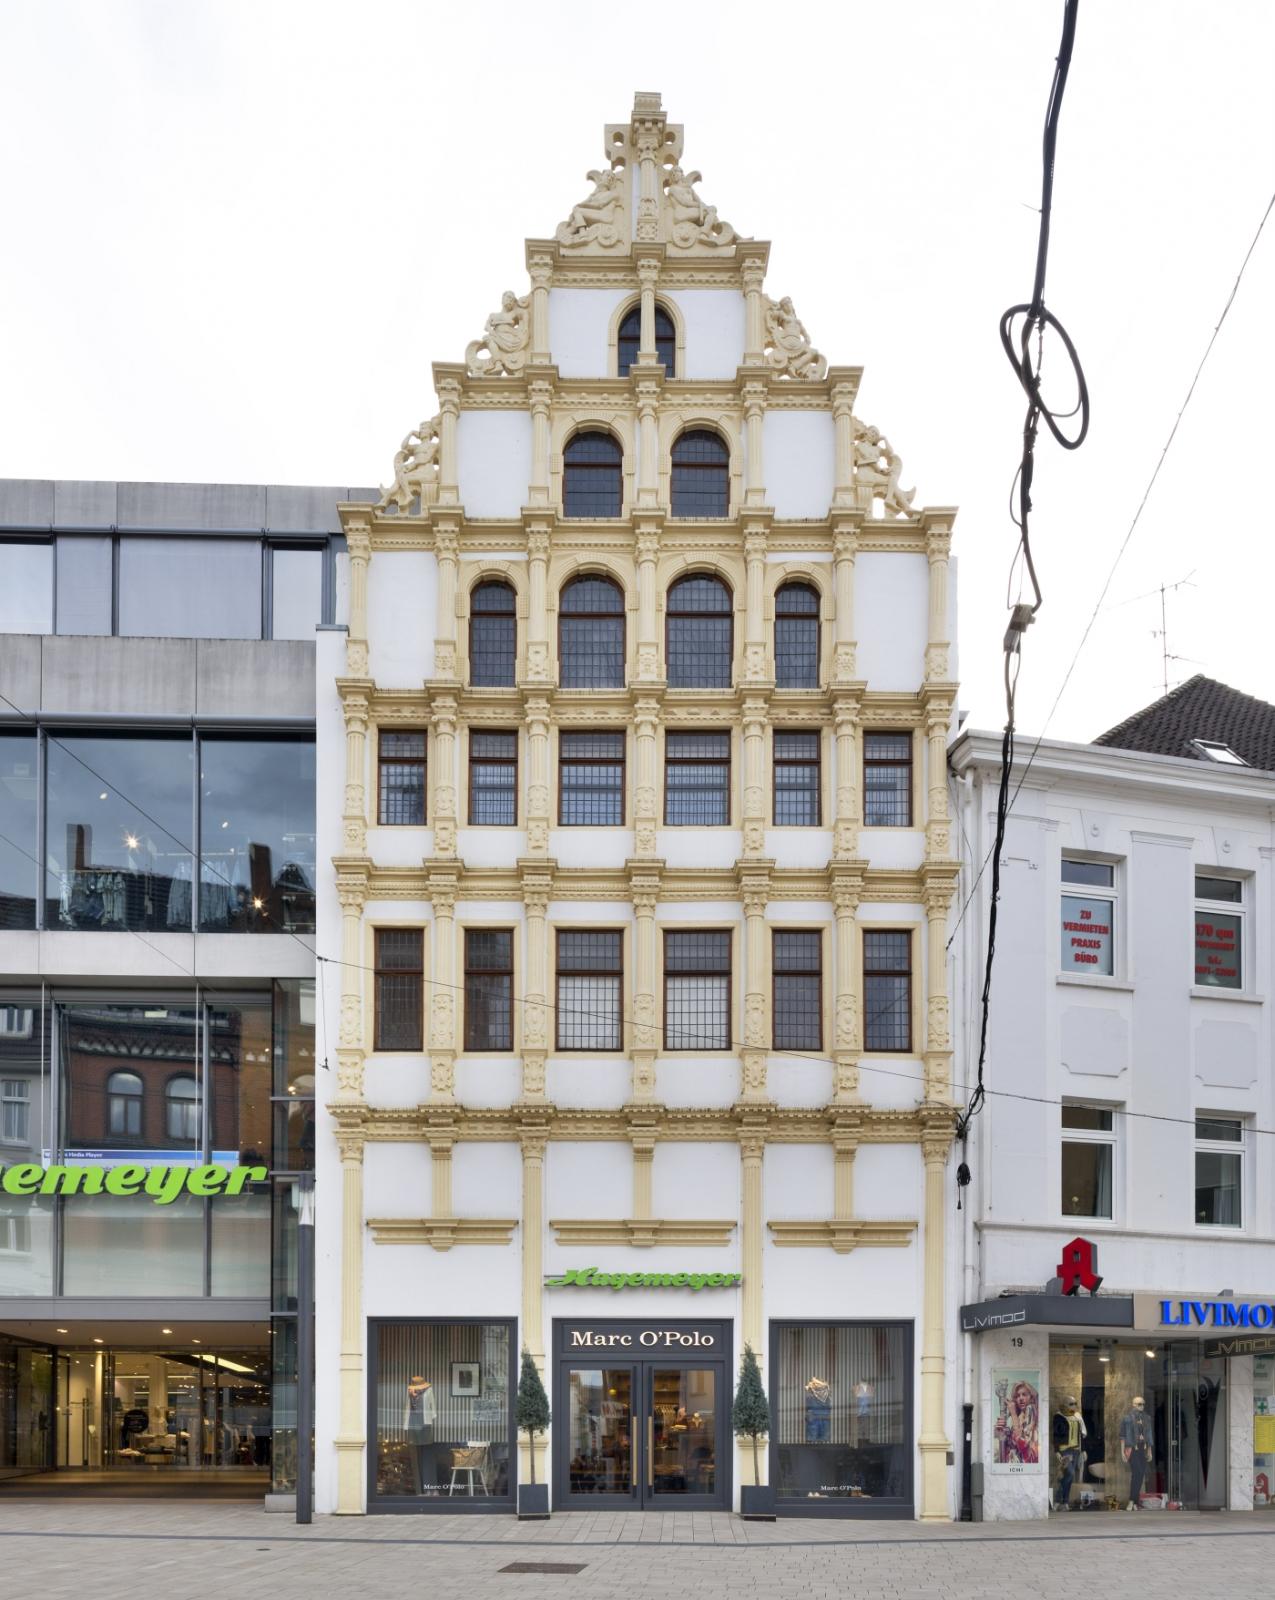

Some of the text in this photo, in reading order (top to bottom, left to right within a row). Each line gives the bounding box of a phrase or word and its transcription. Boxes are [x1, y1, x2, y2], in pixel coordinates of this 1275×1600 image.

[1080, 910, 1092, 920] ZU
[1063, 922, 1109, 935] VERMIETEN
[1071, 937, 1101, 949] PRAXIS
[1074, 951, 1098, 964] BÜRO
[0, 1163, 268, 1206] emeyer
[546, 1267, 741, 1291] Hagemeyer
[1159, 1300, 1275, 1329] LIVIMO
[571, 1330, 714, 1347] Marc O'Polo
[1011, 1337, 1023, 1347] 19
